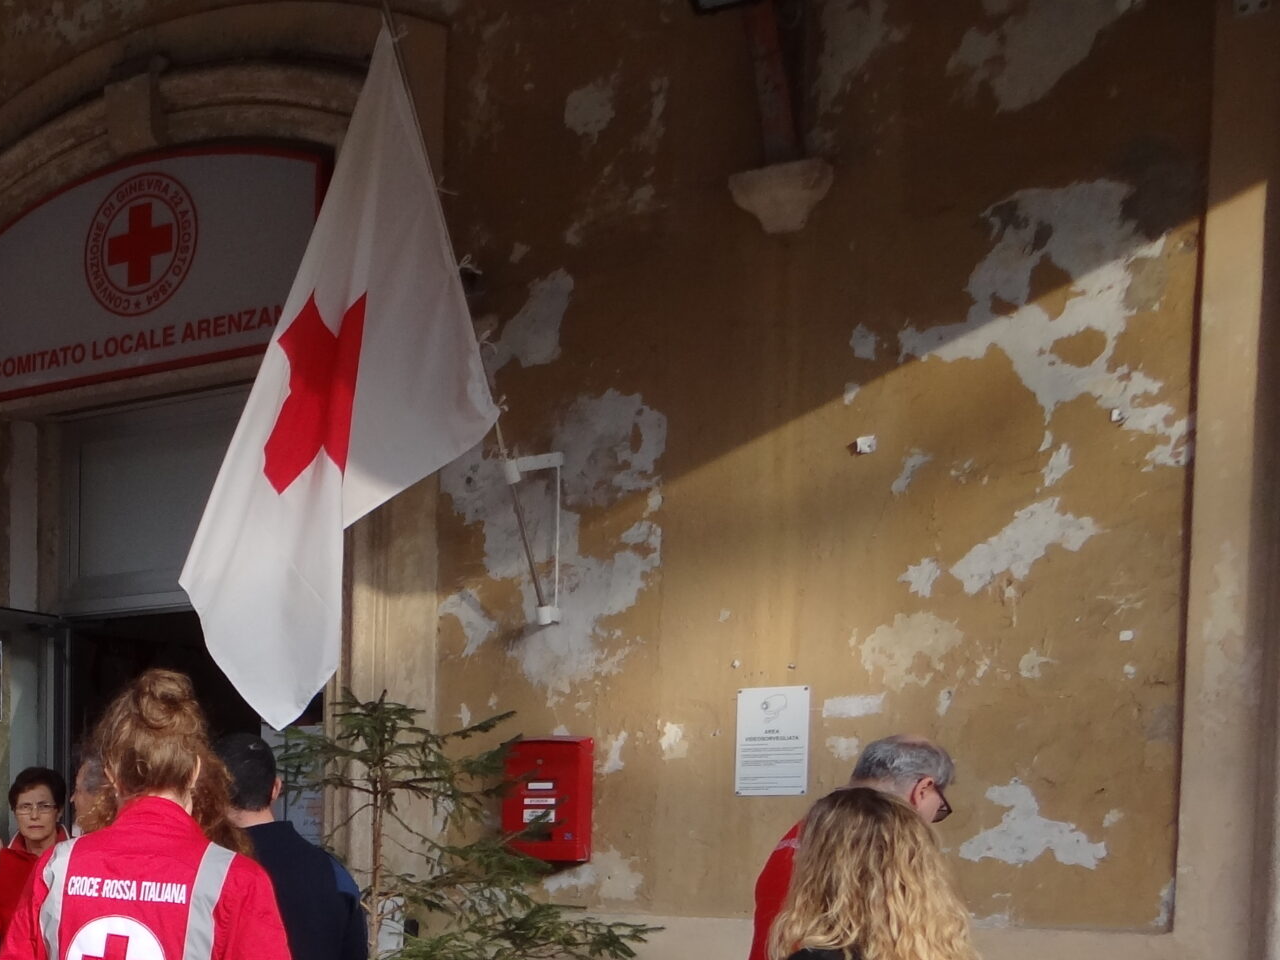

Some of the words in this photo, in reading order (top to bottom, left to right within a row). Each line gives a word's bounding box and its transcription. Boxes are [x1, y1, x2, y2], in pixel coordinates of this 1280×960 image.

[116, 178, 170, 202] GINEVRA
[102, 202, 116, 218] DI
[172, 209, 192, 277] AGOSTO
[90, 223, 131, 311] CONVENZIONE
[146, 280, 173, 305] 1864
[92, 324, 176, 361] LOCALE
[67, 876, 102, 897] CROCE
[102, 879, 137, 901] ROSSA
[140, 881, 187, 905] ITALIANA
